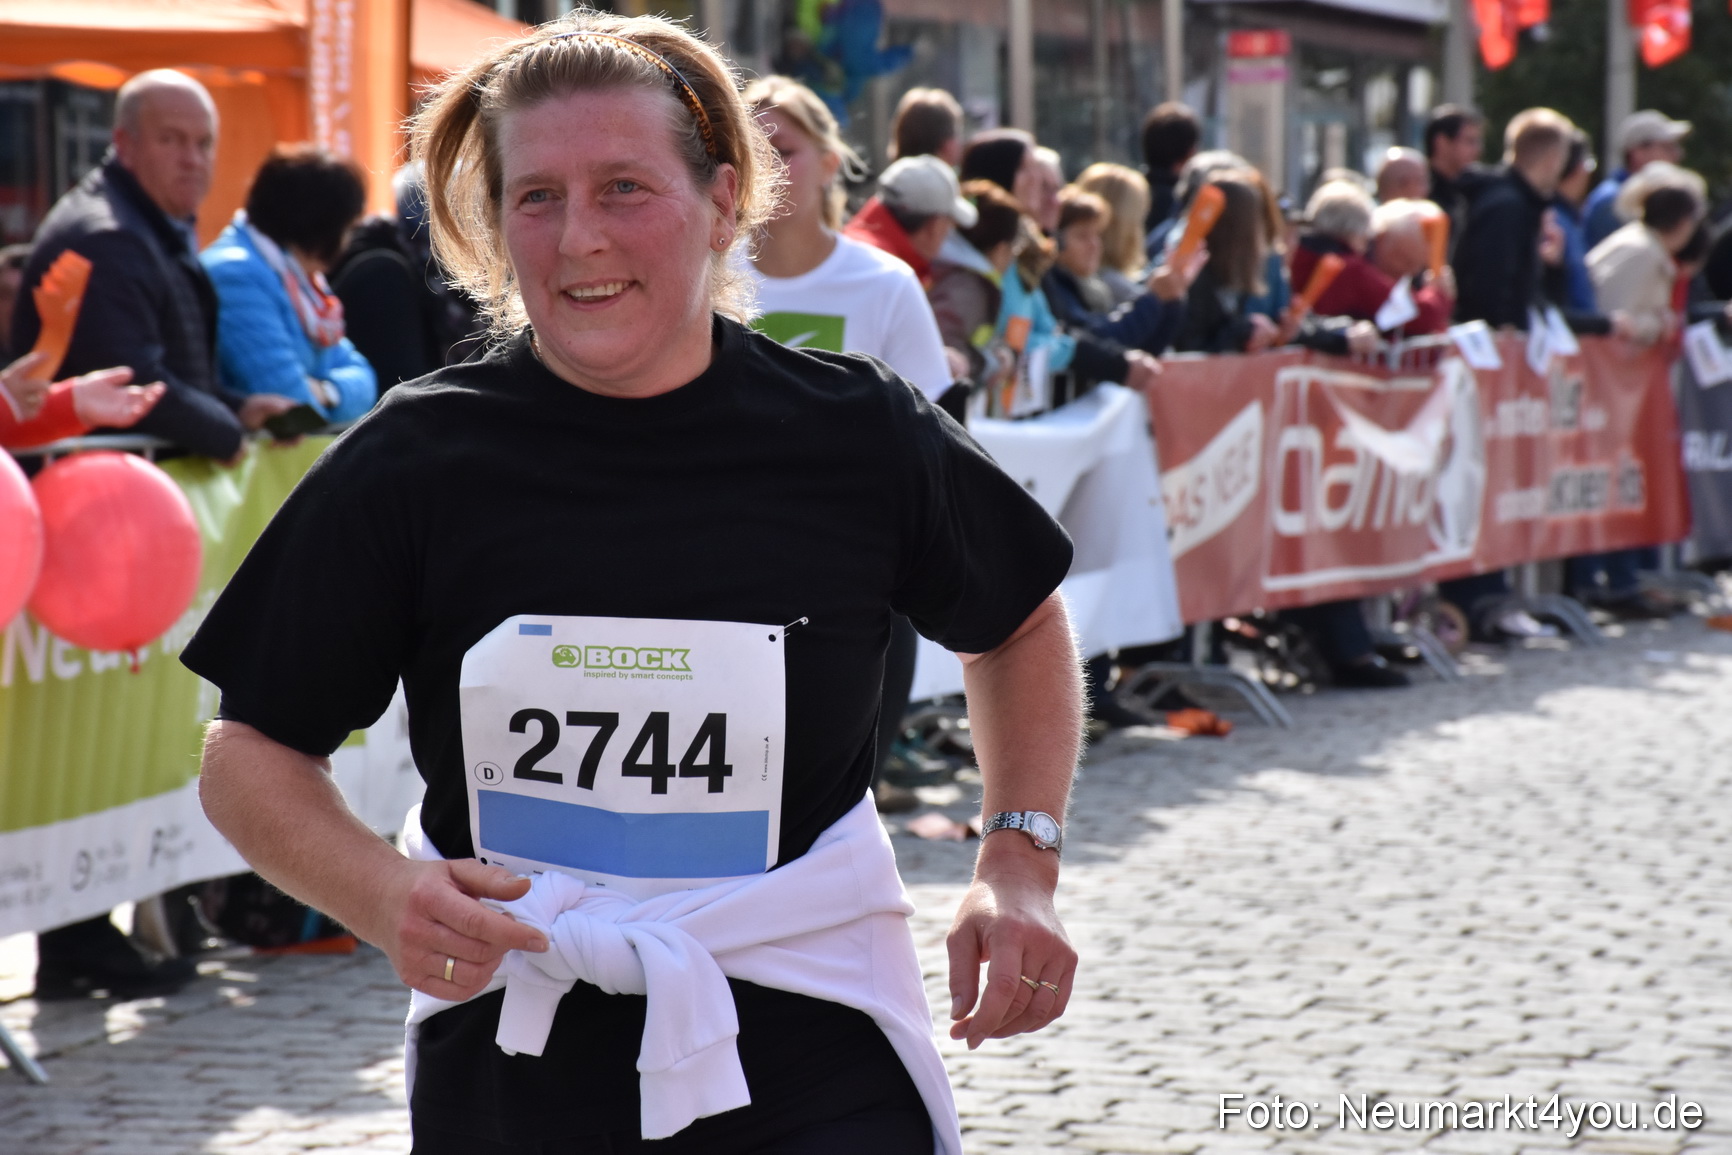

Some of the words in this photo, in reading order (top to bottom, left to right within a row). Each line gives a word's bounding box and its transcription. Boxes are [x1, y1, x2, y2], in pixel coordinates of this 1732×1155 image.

[584, 645, 692, 671] BOCK
[583, 670, 617, 680] inspired
[619, 671, 629, 680] by
[630, 672, 655, 680] smart
[656, 673, 694, 681] concepts
[509, 708, 733, 795] 2744
[483, 767, 495, 780] D
